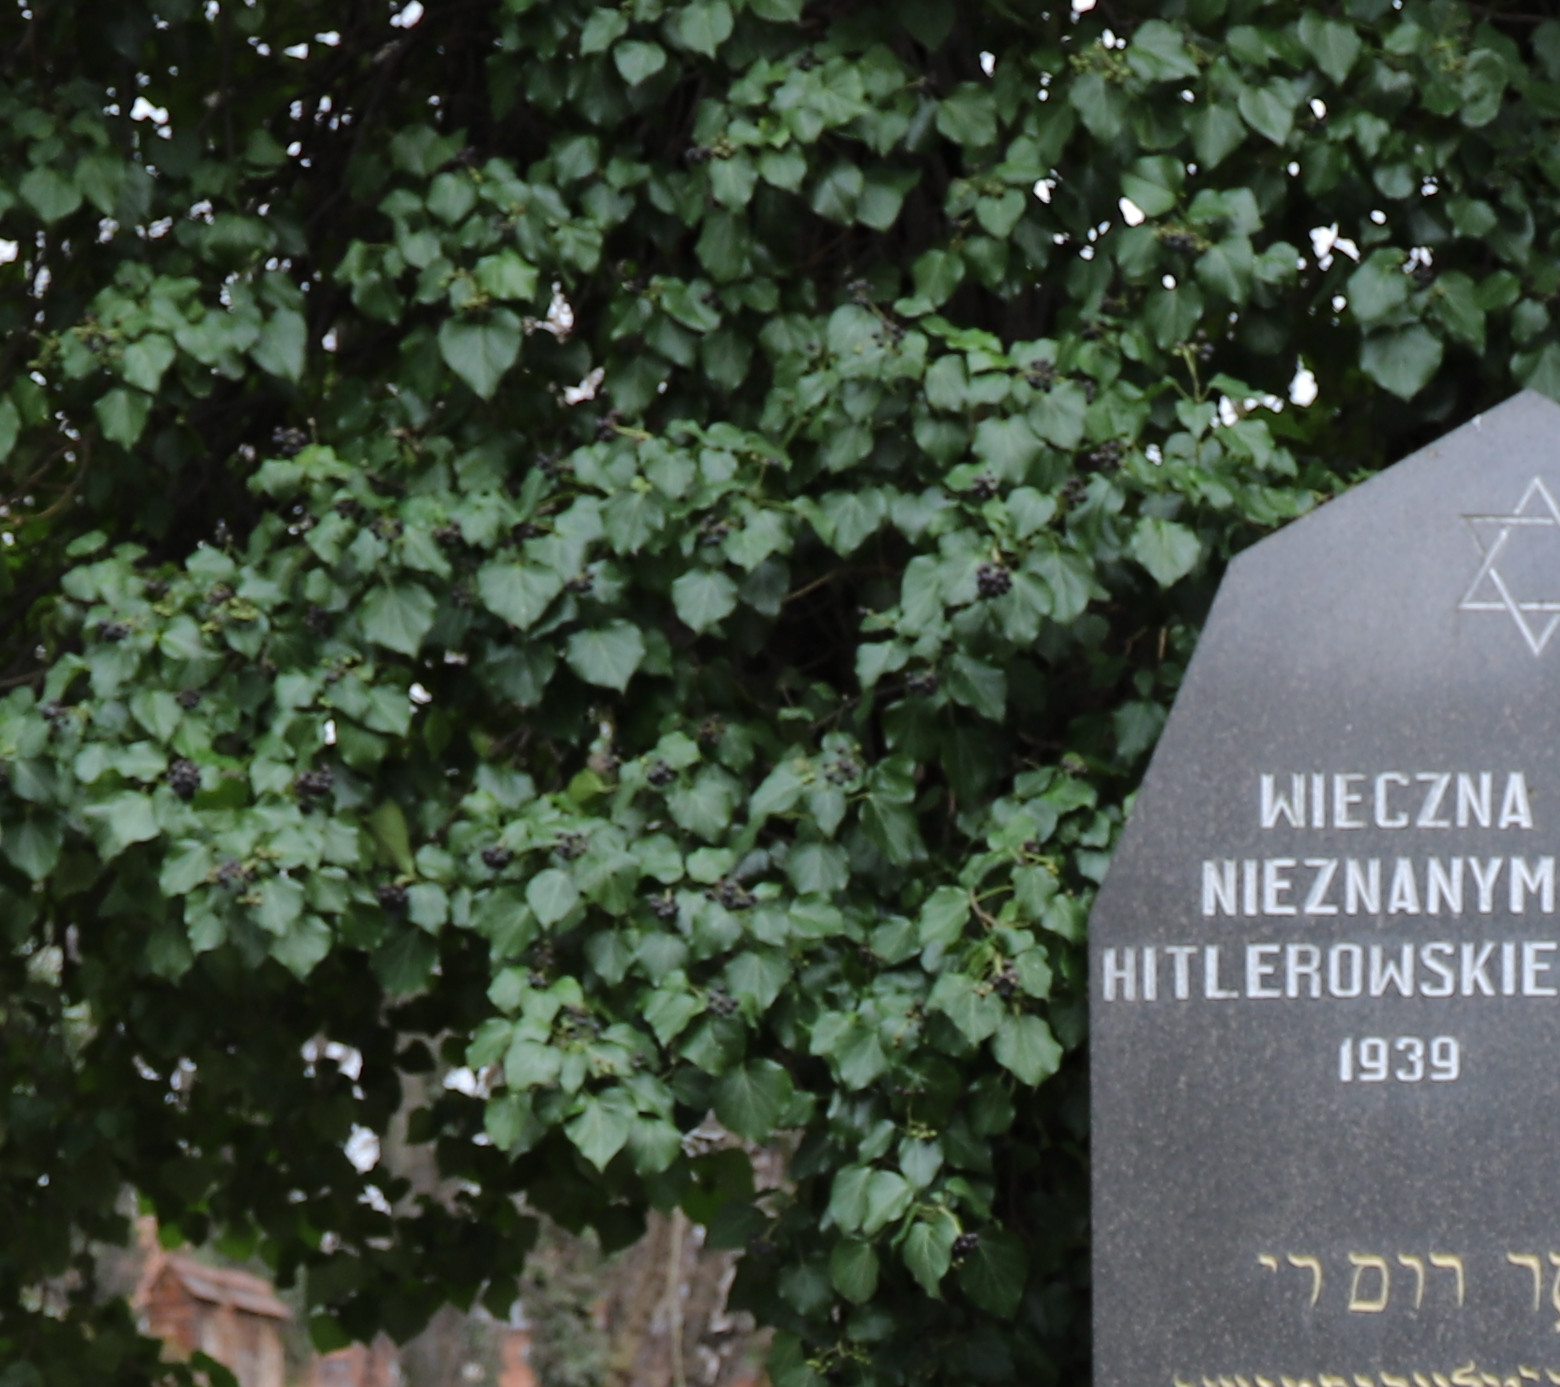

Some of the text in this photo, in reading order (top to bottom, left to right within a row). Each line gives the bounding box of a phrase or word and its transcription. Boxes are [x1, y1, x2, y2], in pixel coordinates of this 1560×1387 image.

[1259, 770, 1534, 830] WIECZNA
[1200, 855, 1556, 917] NIEZNANYM
[1338, 1035, 1463, 1083] 1939
